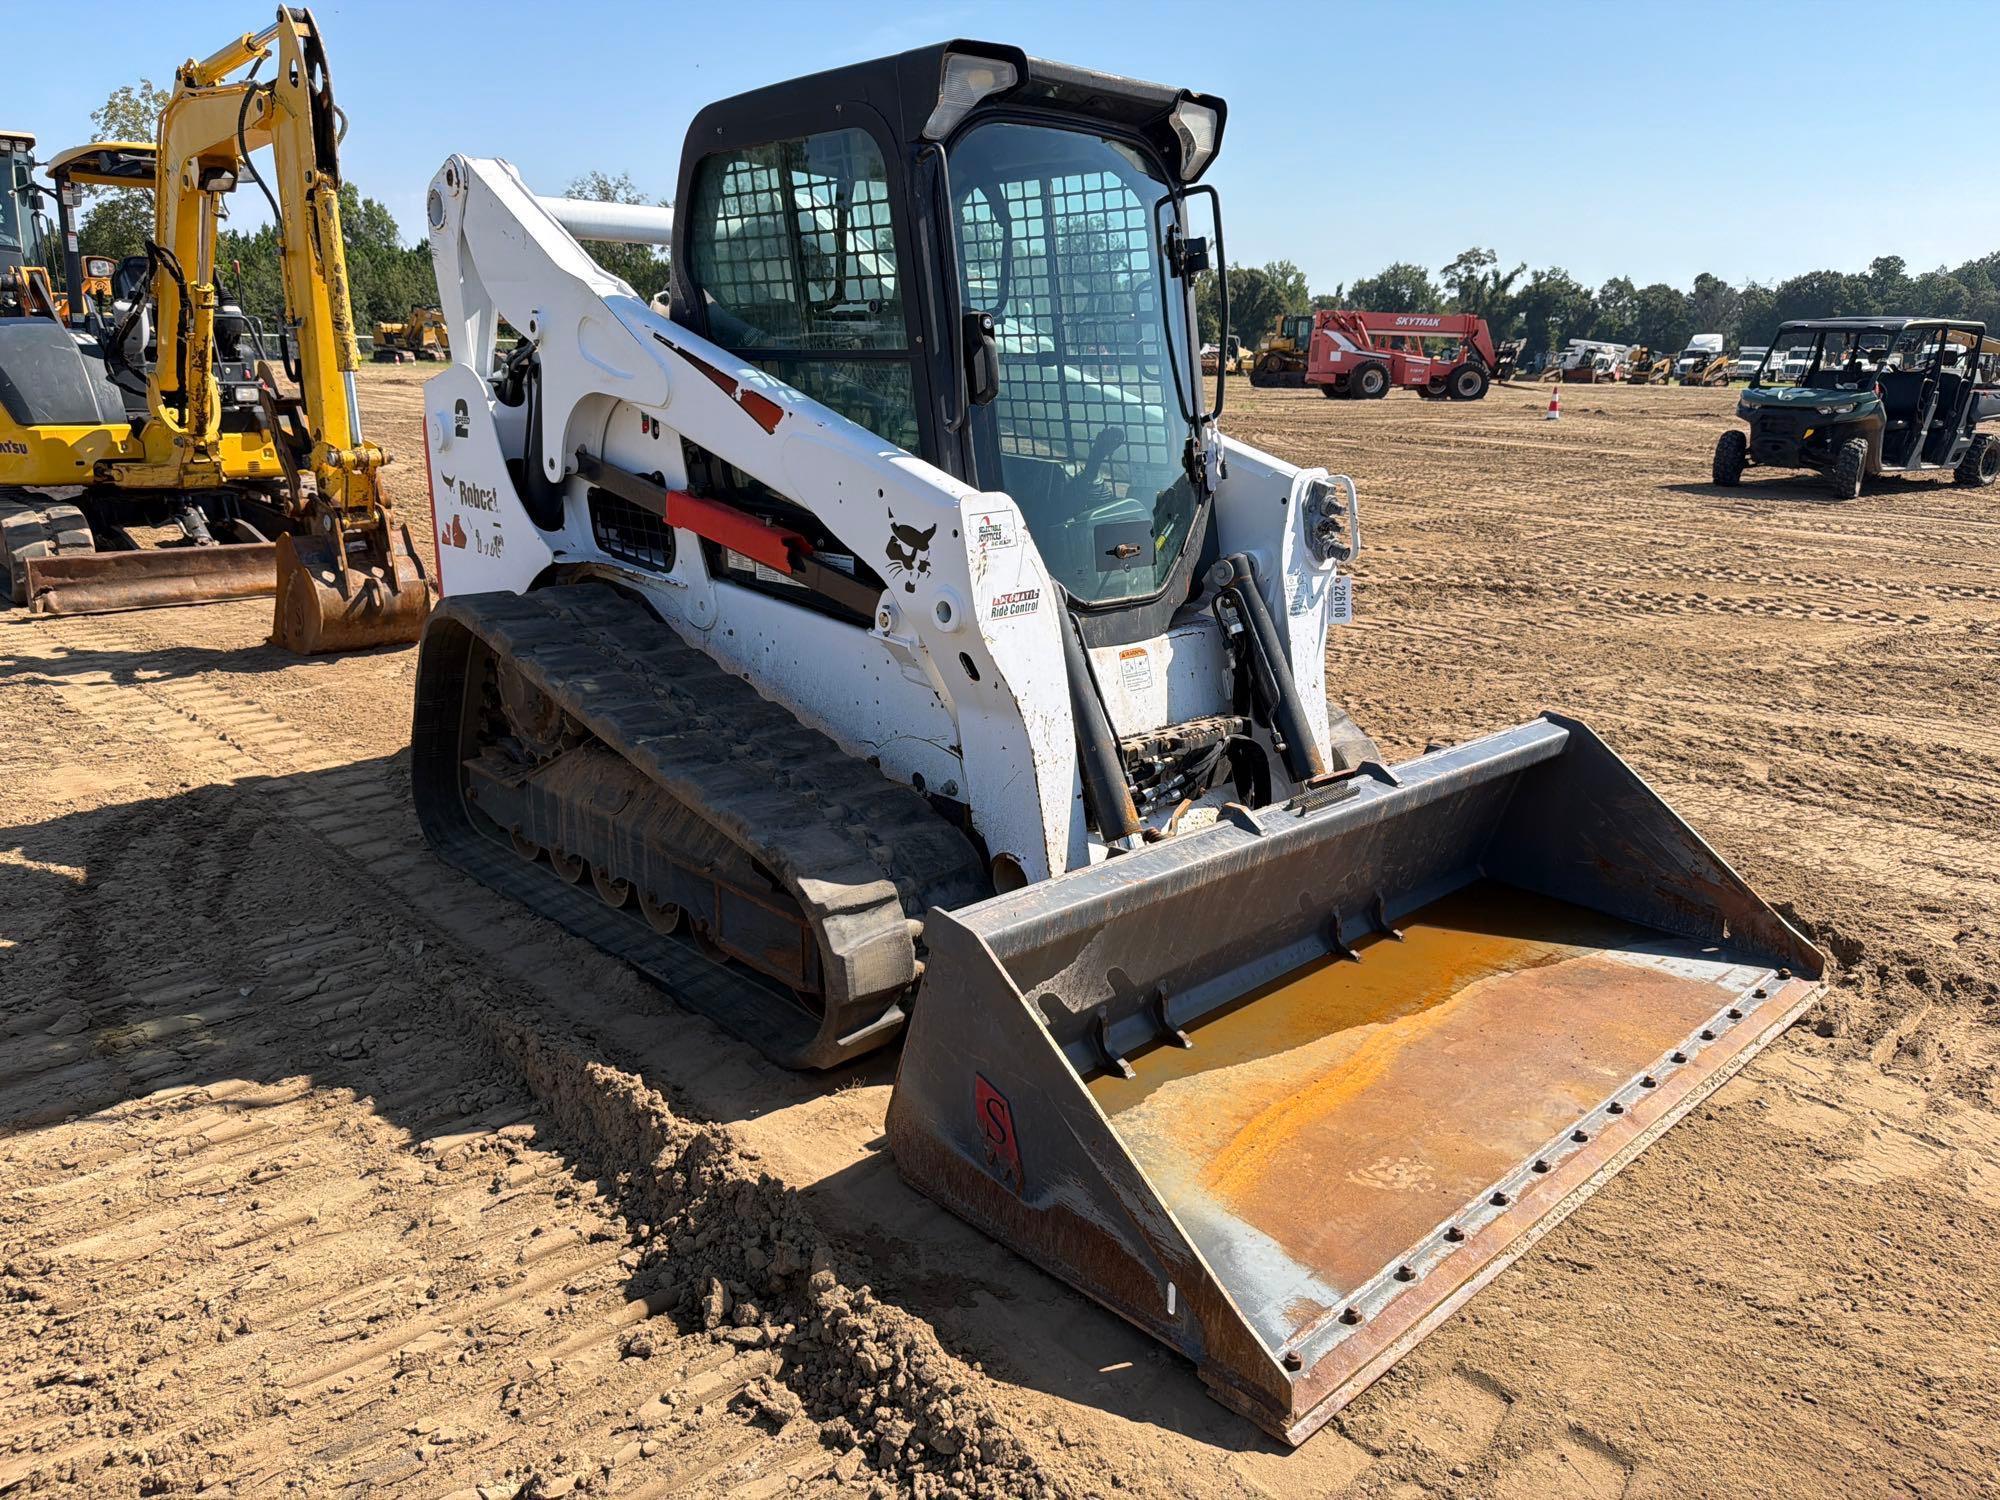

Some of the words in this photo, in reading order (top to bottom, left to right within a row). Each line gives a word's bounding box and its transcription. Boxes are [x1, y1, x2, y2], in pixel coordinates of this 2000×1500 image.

[1395, 316, 1441, 327] SKYTRAK
[991, 604, 1009, 618] Ride
[1010, 600, 1039, 615] Control
[1334, 585, 1346, 618] 226108
